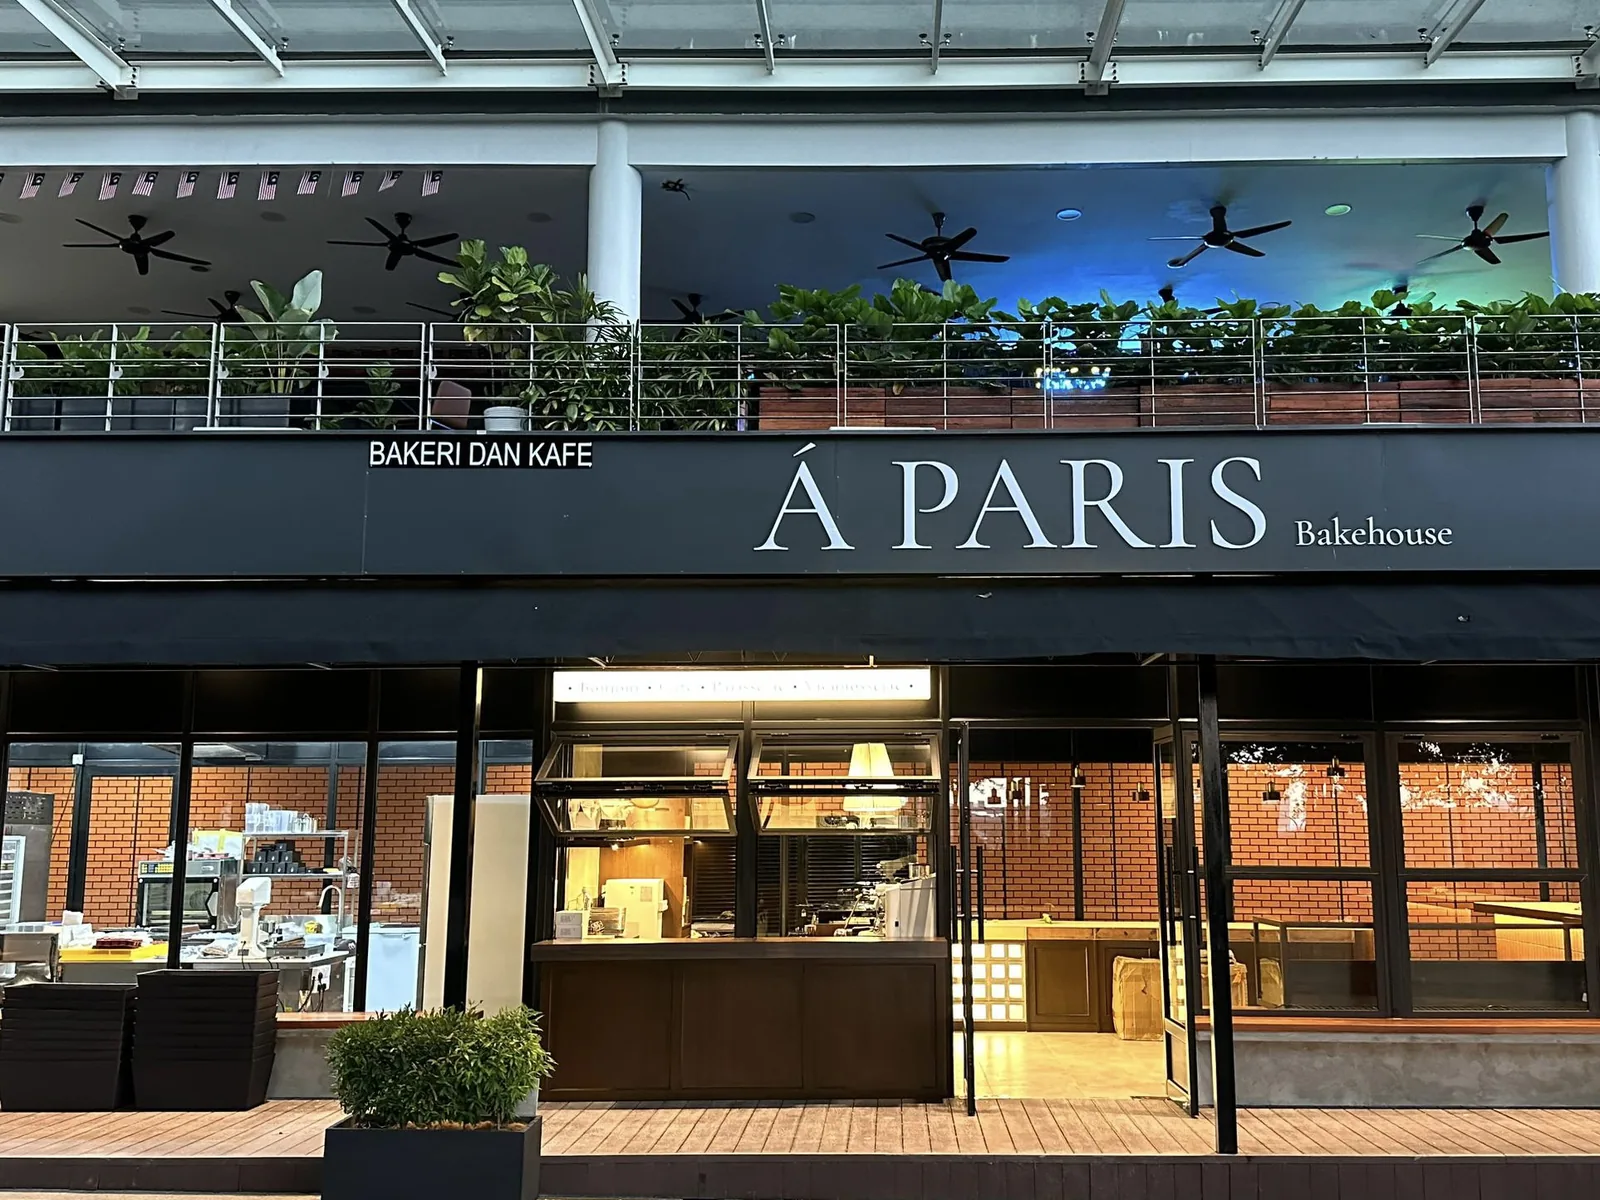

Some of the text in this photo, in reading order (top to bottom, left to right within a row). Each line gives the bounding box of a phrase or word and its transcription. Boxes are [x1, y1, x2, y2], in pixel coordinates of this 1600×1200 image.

[370, 441, 592, 467] BAKERI DAN KAFE
[753, 442, 1267, 551] Á PARIS
[1294, 516, 1453, 547] Bakehouse
